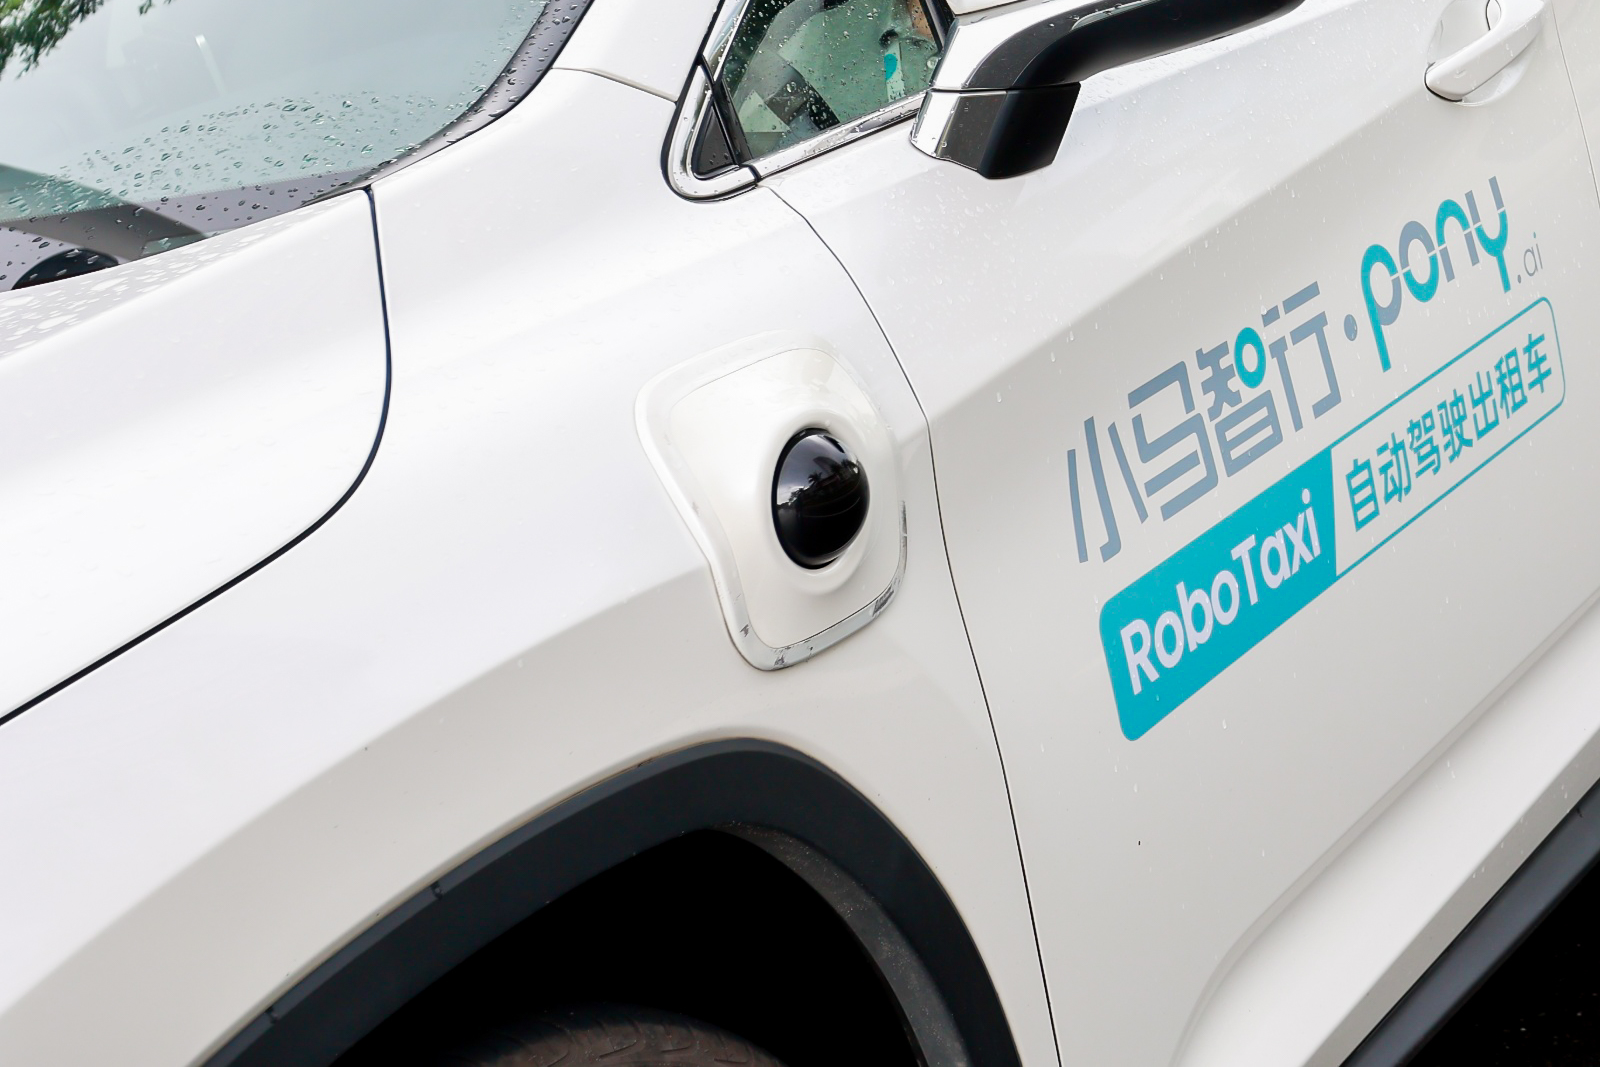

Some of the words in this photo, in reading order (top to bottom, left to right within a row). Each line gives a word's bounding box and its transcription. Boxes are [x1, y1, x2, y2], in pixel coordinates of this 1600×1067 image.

[1345, 333, 1553, 533] 自动驾驶出租车
[1120, 488, 1322, 696] RoboTaxi
